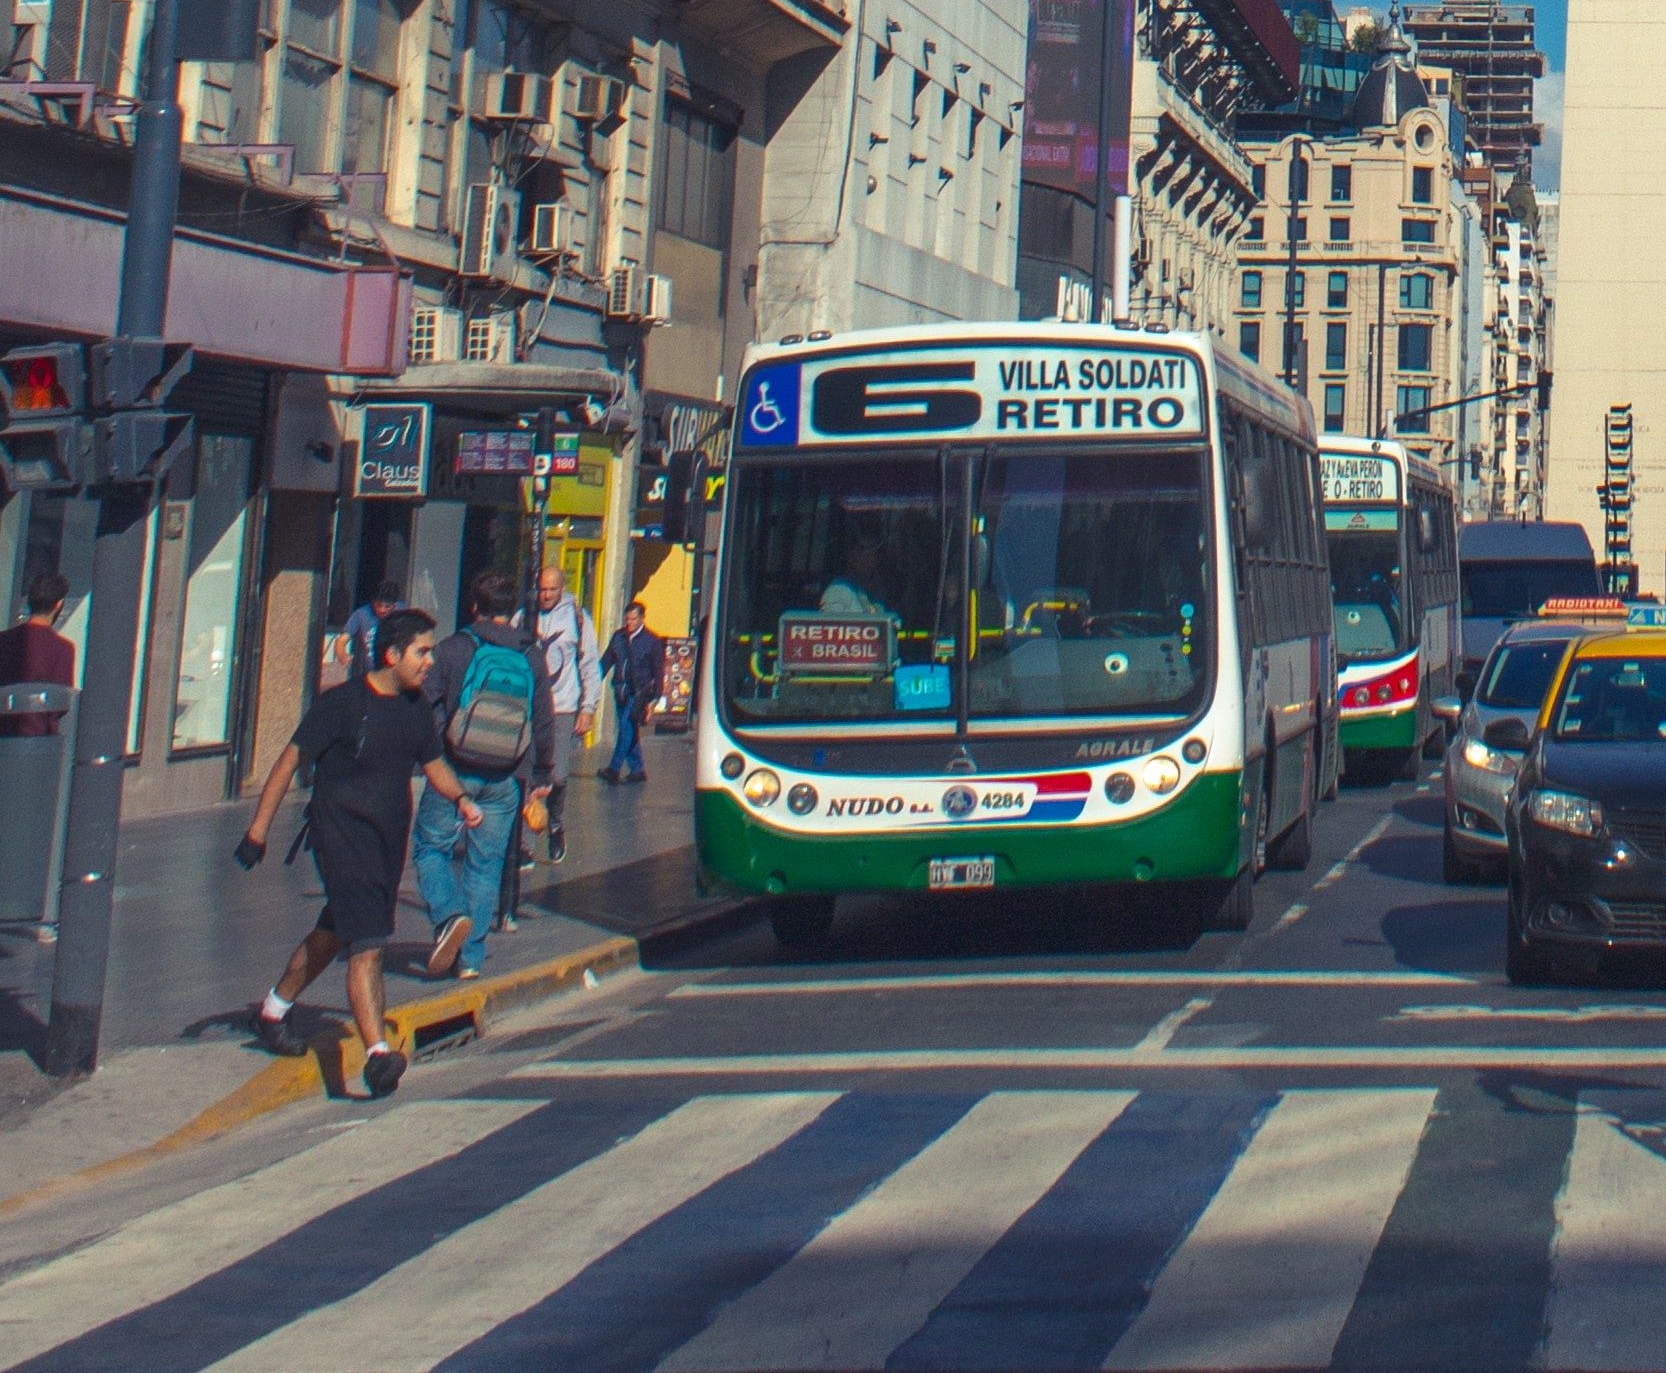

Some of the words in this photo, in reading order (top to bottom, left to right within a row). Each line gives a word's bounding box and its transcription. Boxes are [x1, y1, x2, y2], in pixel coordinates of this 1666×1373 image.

[1000, 360, 1071, 391] VILLA
[1079, 359, 1186, 390] SOLDATI
[811, 361, 982, 436] 6
[997, 396, 1185, 429] RETIRO
[361, 461, 420, 480] Claus
[556, 457, 576, 469] 180
[1349, 480, 1383, 498] RETIRO
[1548, 598, 1620, 610] RADIOTAXI
[790, 625, 879, 640] RETIRO
[812, 643, 878, 658] BRASIL
[900, 679, 945, 696] SUBE
[826, 796, 905, 817] NUDO
[981, 792, 1025, 809] 4284
